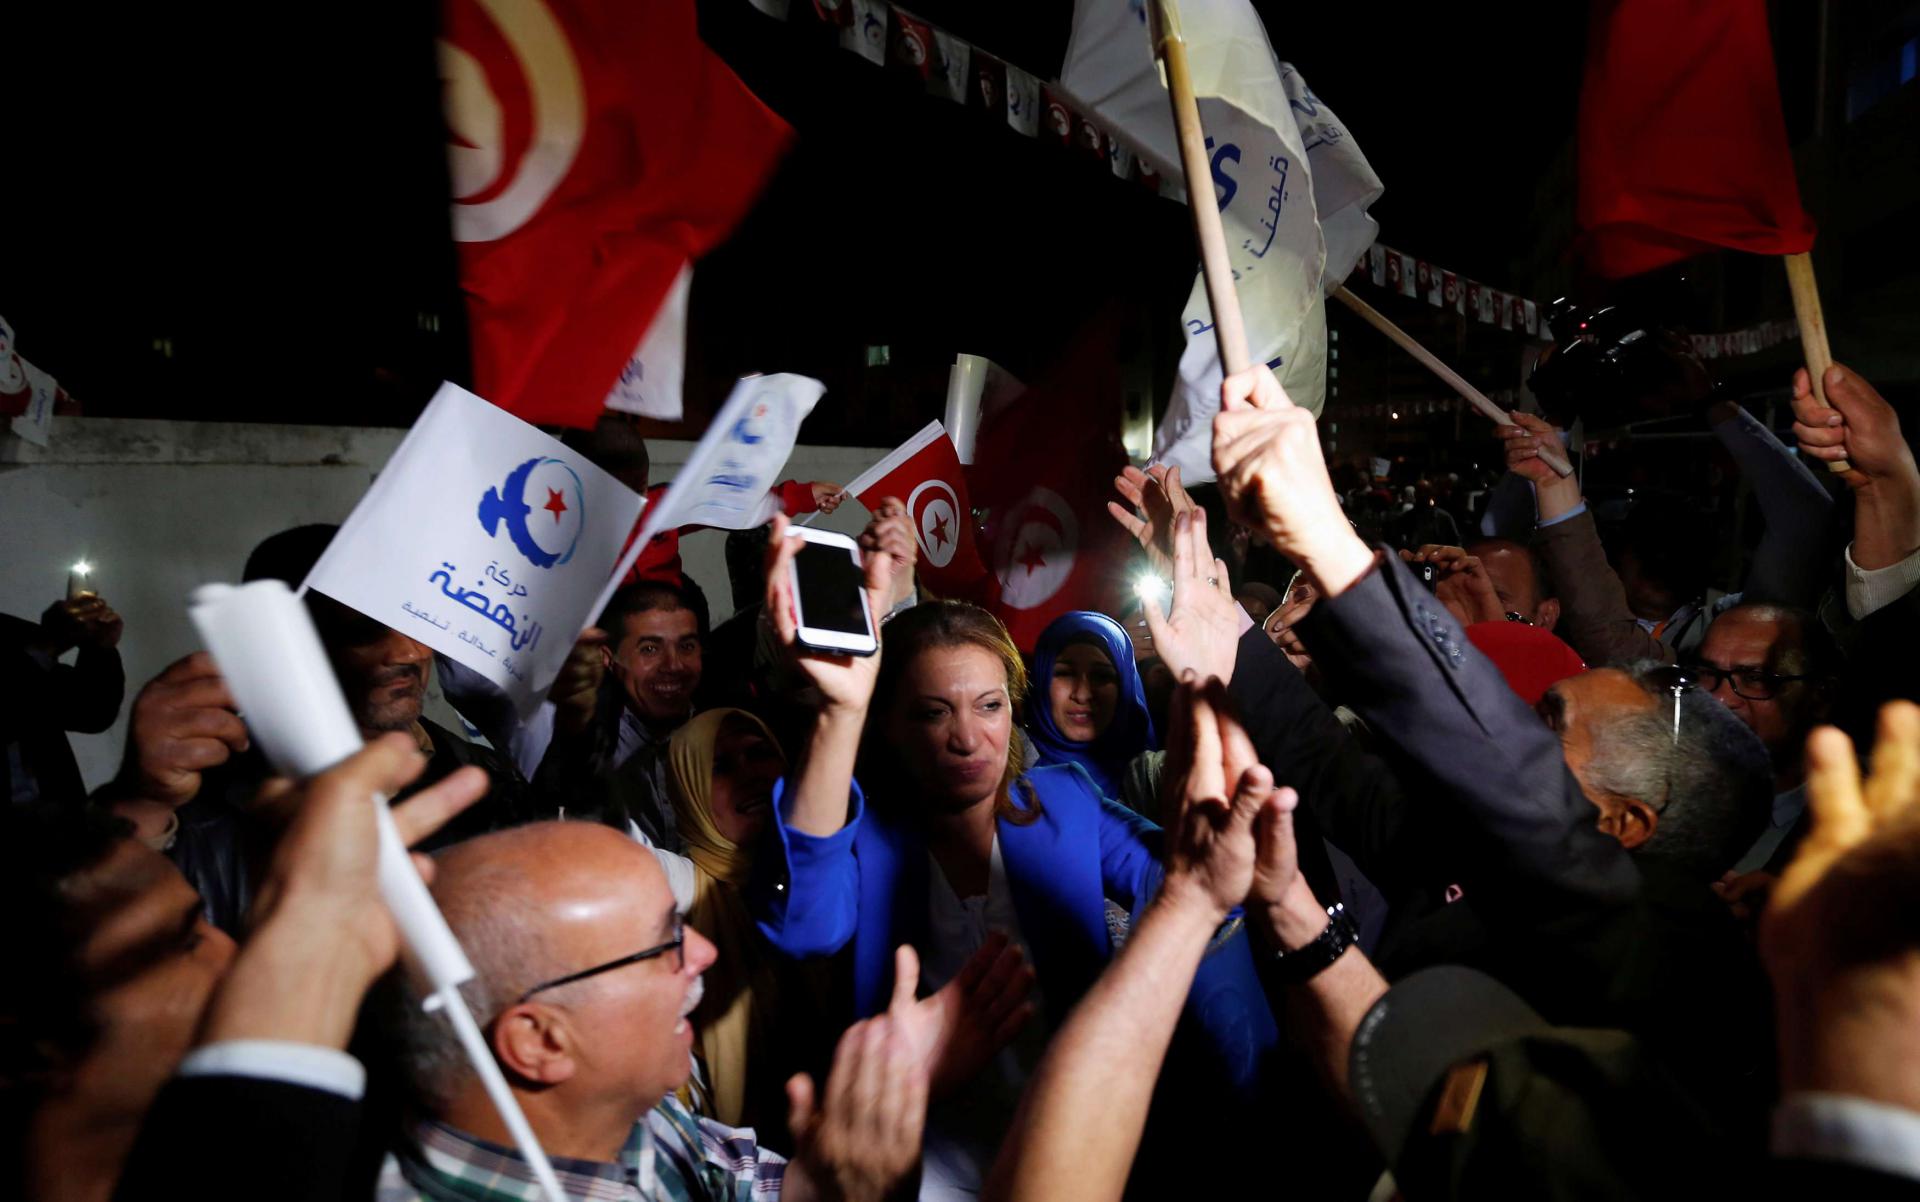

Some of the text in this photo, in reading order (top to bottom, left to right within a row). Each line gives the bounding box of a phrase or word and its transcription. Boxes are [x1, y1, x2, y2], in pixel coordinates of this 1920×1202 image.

[485, 560, 528, 597] حركة
[428, 561, 543, 651] النهضة
[457, 630, 497, 657] عدالة
